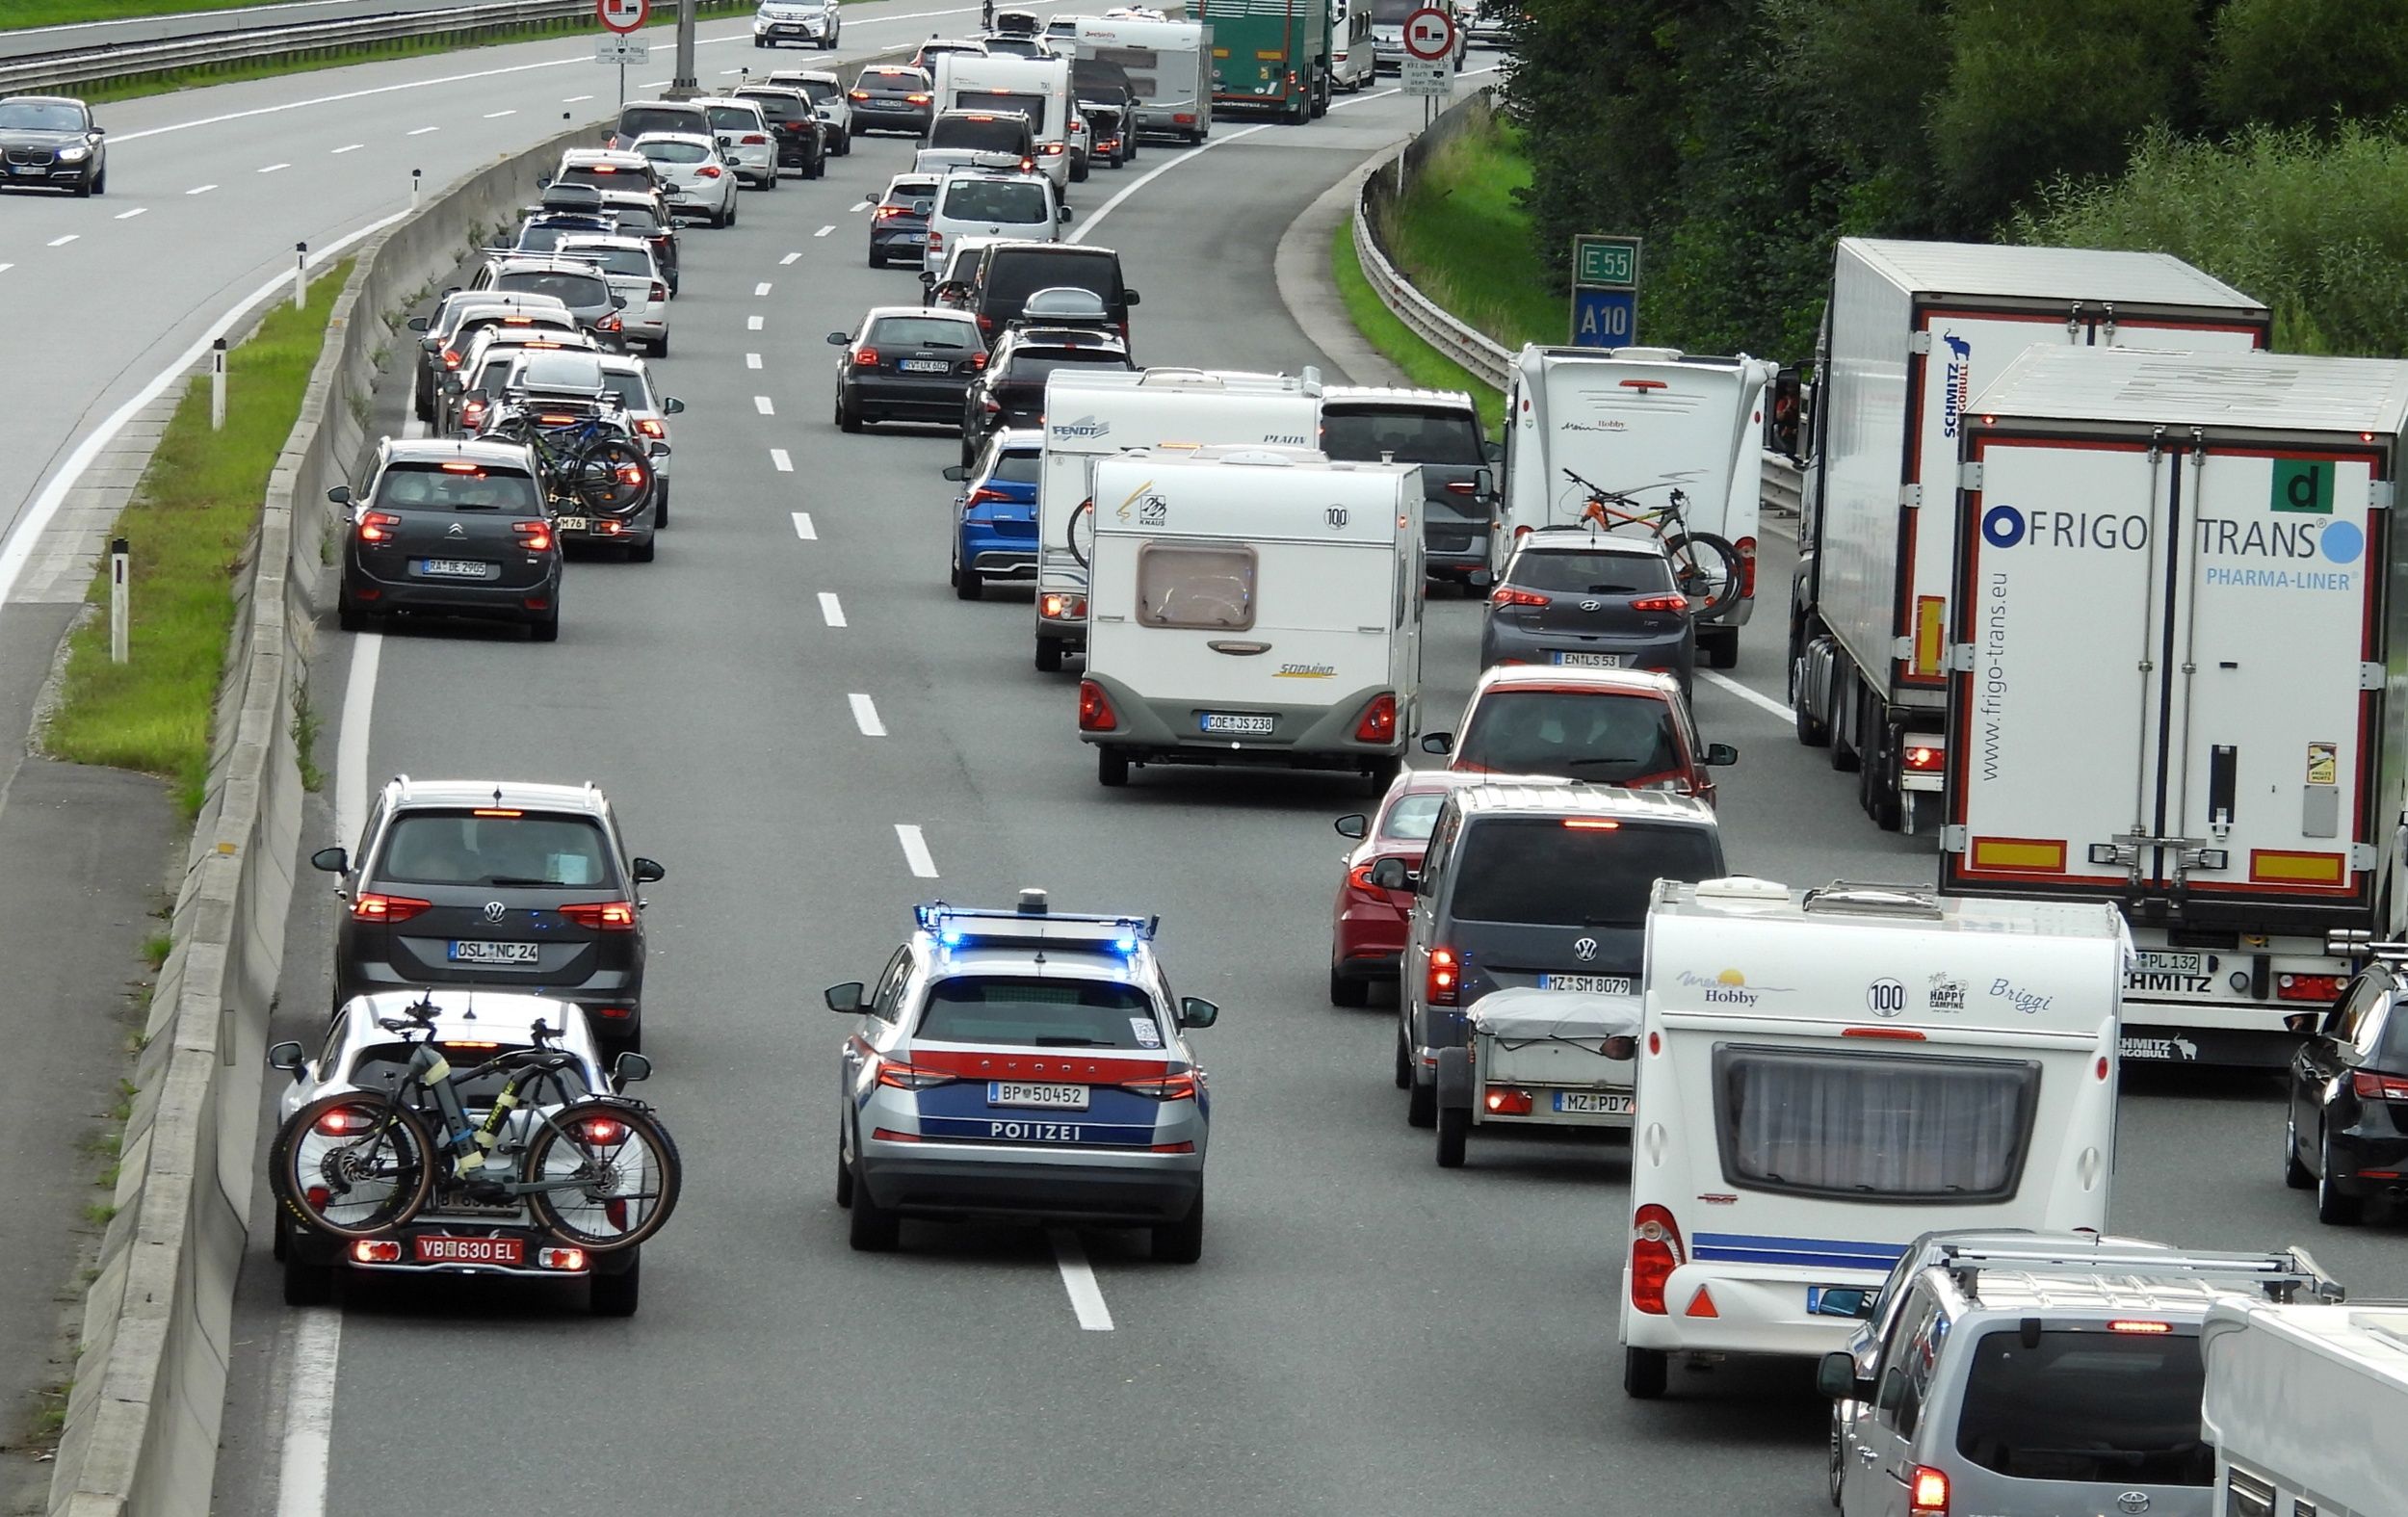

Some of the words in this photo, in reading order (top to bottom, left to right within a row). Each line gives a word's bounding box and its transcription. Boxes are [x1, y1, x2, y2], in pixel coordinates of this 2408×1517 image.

[1585, 251, 1600, 274] E
[1605, 253, 1628, 275] 55
[1581, 304, 1597, 333] A
[1601, 306, 1626, 335] 10
[1944, 363, 1959, 437] SCHMITZ
[1957, 364, 1968, 436] GOBULL
[1053, 426, 1097, 435] FENDT
[2287, 465, 2319, 509] d
[570, 519, 582, 528] 76
[1327, 509, 1347, 525] 100
[2028, 510, 2149, 551] FRIGO
[431, 562, 441, 570] RA
[449, 562, 459, 572] DE
[462, 562, 484, 572] 2905
[2207, 559, 2350, 590] PHARMA-LINER
[1565, 655, 1580, 665] EN
[1585, 656, 1599, 666] LS
[1603, 657, 1615, 667] 53
[1980, 572, 2007, 781] www.frigo-trans.eu
[1209, 717, 1228, 728] COE
[1237, 719, 1249, 729] JS
[1252, 719, 1271, 730] 238
[458, 943, 485, 957] OSL
[496, 945, 515, 958] NC
[520, 945, 537, 958] 24
[2150, 955, 2167, 968] PL
[2171, 955, 2197, 969] 132
[1549, 977, 1565, 990] MZ
[1576, 978, 1592, 991] SM
[1596, 979, 1629, 993] 8079
[2123, 973, 2212, 992] HMITZ
[1705, 990, 1759, 1007] Hobby
[1871, 985, 1903, 1010] 100
[1930, 990, 1965, 1002] HAPPY
[1989, 978, 2053, 1014] Briggi
[1929, 1001, 1964, 1009] CAMPING
[2120, 1038, 2171, 1050] HMITZ
[2119, 1049, 2171, 1059] RGOBULL
[1003, 1086, 1021, 1100] BP
[1034, 1087, 1081, 1103] 50452
[1568, 1095, 1587, 1110] MZ
[1599, 1096, 1617, 1111] PD
[991, 1122, 1080, 1140] POLIZEI
[424, 1241, 443, 1257] VB
[458, 1242, 490, 1259] 630
[495, 1243, 515, 1259] EL
